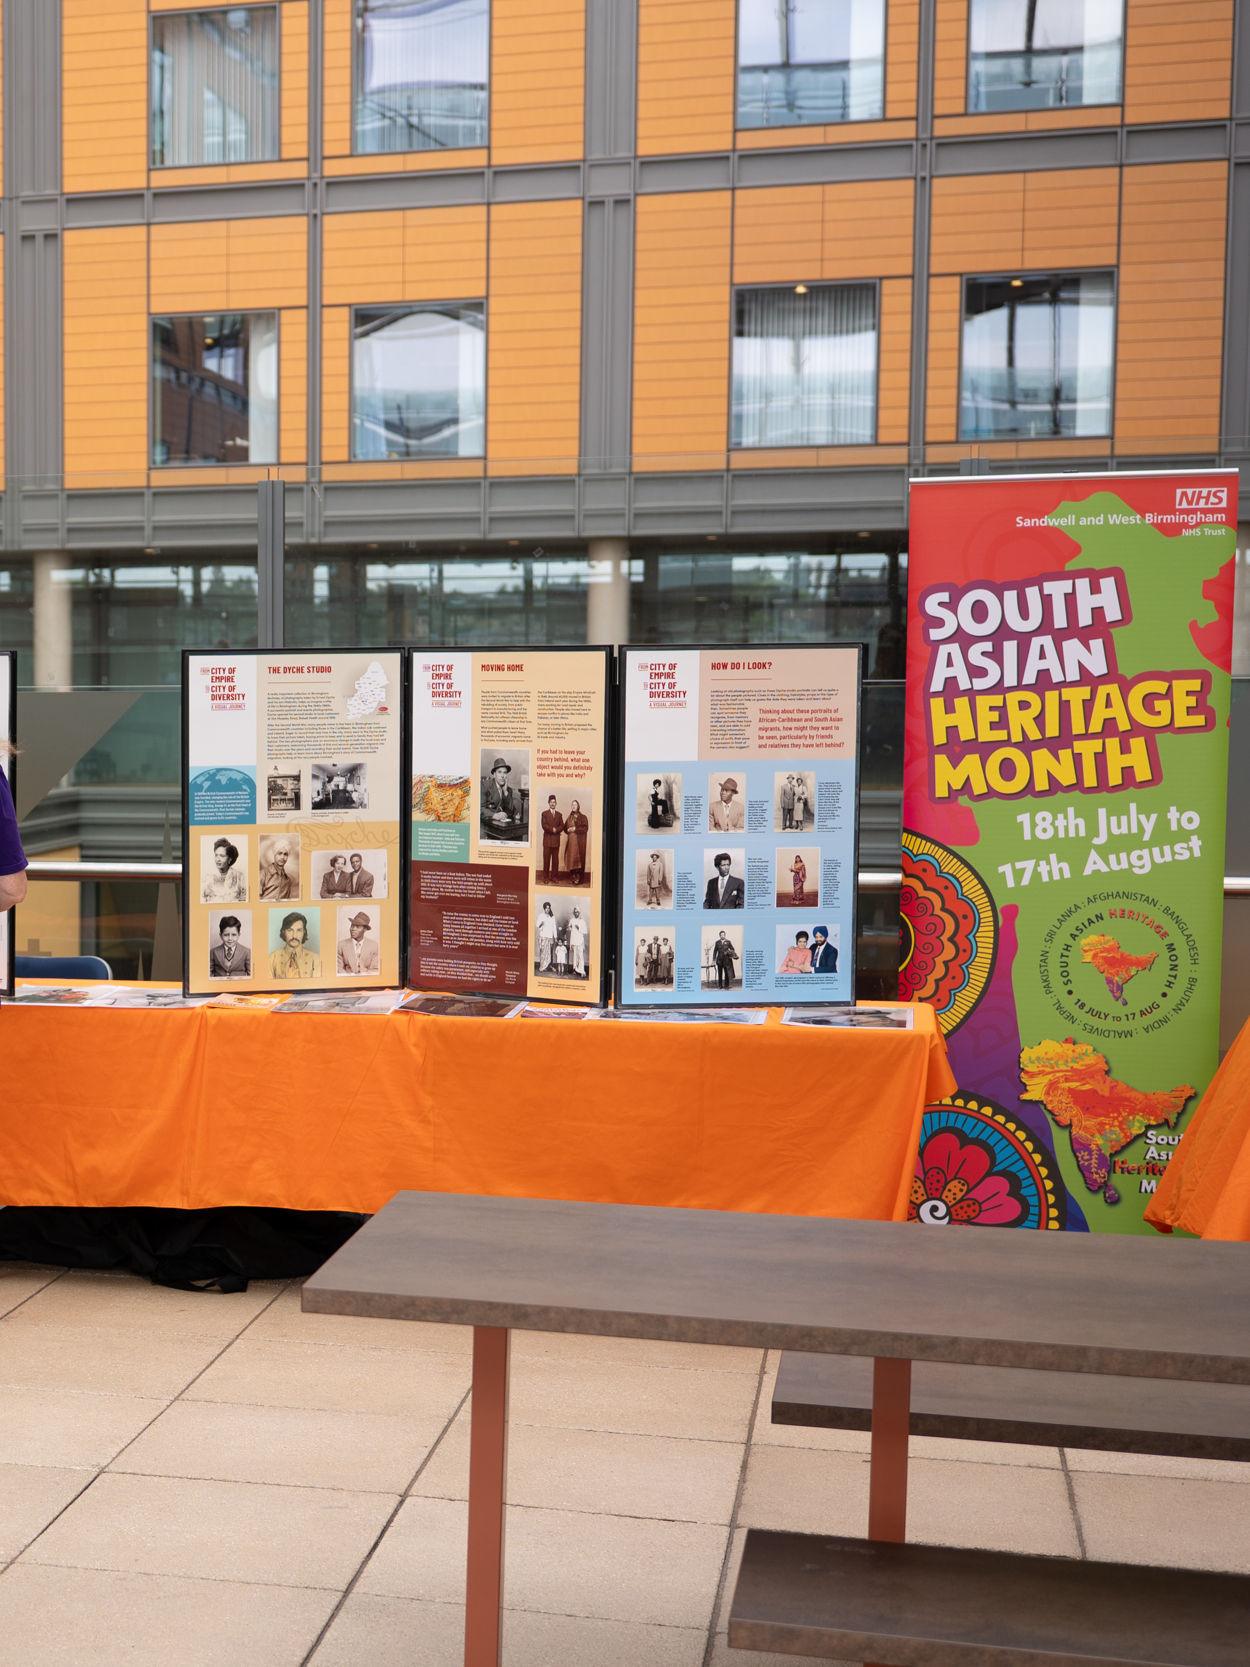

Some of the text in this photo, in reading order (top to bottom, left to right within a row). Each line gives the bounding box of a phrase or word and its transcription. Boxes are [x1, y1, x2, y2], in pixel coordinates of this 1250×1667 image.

[1016, 512, 1226, 527] Sandwell and West Birmingham
[1177, 489, 1226, 507] NHS
[1203, 528, 1226, 536] Trust
[924, 576, 1122, 641] SOUTH
[930, 635, 1109, 693] ASIAN
[930, 679, 1207, 746] HERITAGE
[934, 737, 1153, 799] MONTH
[1016, 803, 1200, 845] 18th July to
[998, 835, 1203, 888] 17th August
[1039, 891, 1200, 1038] SRI LANKA AFGHANISTAN BANGLADESH BHUTAN INDIA MALDIVES NEPAL PAKISTAN
[1059, 908, 1179, 989] SOUTH ASIAN HERITAGE MONTH
[1074, 998, 1086, 1011] 18
[1085, 1007, 1110, 1022] JULY
[1124, 1012, 1136, 1022] 17
[1139, 1001, 1161, 1018] AUG
[1144, 1146, 1175, 1160] Asi
[1145, 1130, 1184, 1145] Sout
